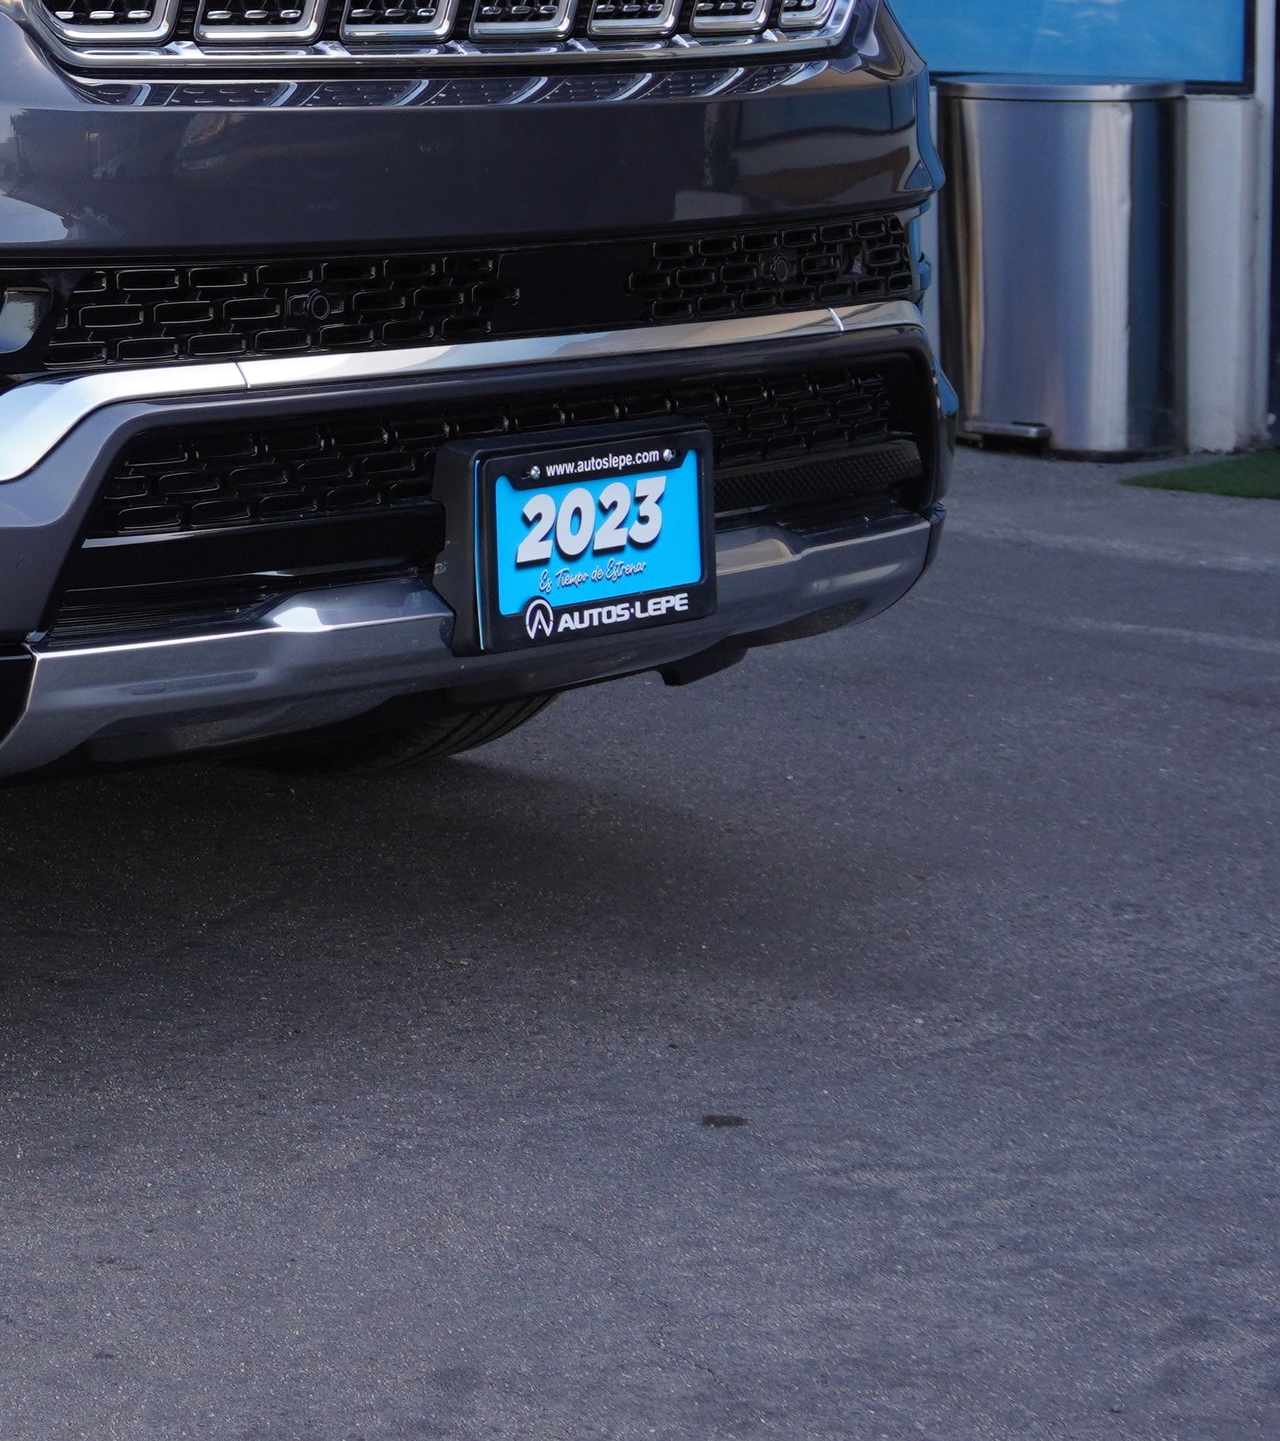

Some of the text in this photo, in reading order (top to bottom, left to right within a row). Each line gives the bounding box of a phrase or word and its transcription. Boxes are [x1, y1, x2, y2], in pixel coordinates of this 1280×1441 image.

[545, 448, 660, 478] www.autoslepe.com
[515, 475, 667, 564] 2023
[538, 557, 647, 593] Es Tiempo de Estrenar
